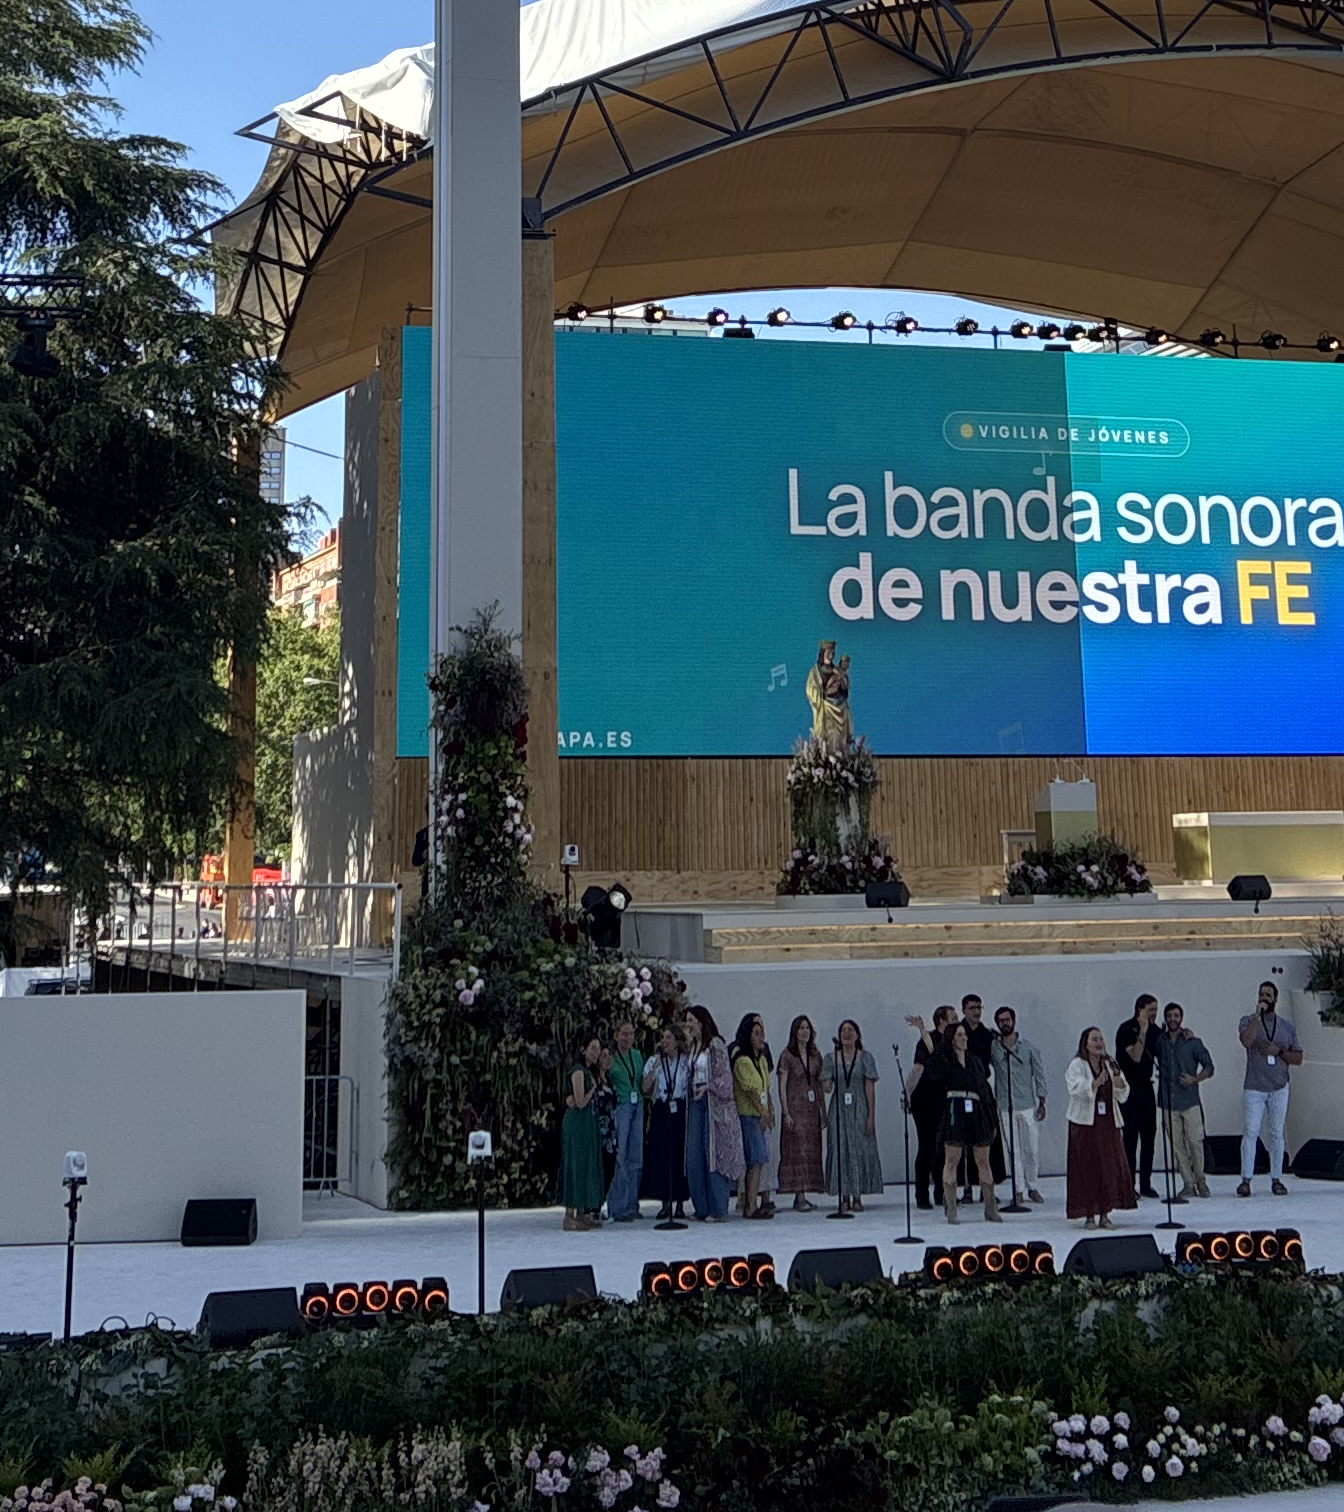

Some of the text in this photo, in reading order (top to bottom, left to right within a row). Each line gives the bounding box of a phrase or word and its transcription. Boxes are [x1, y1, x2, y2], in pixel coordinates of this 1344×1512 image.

[978, 425, 1170, 445] VIGILIA DE JÓVENES
[787, 467, 867, 537] La
[884, 470, 1102, 543] banda
[828, 551, 1317, 626] de nuestra FE
